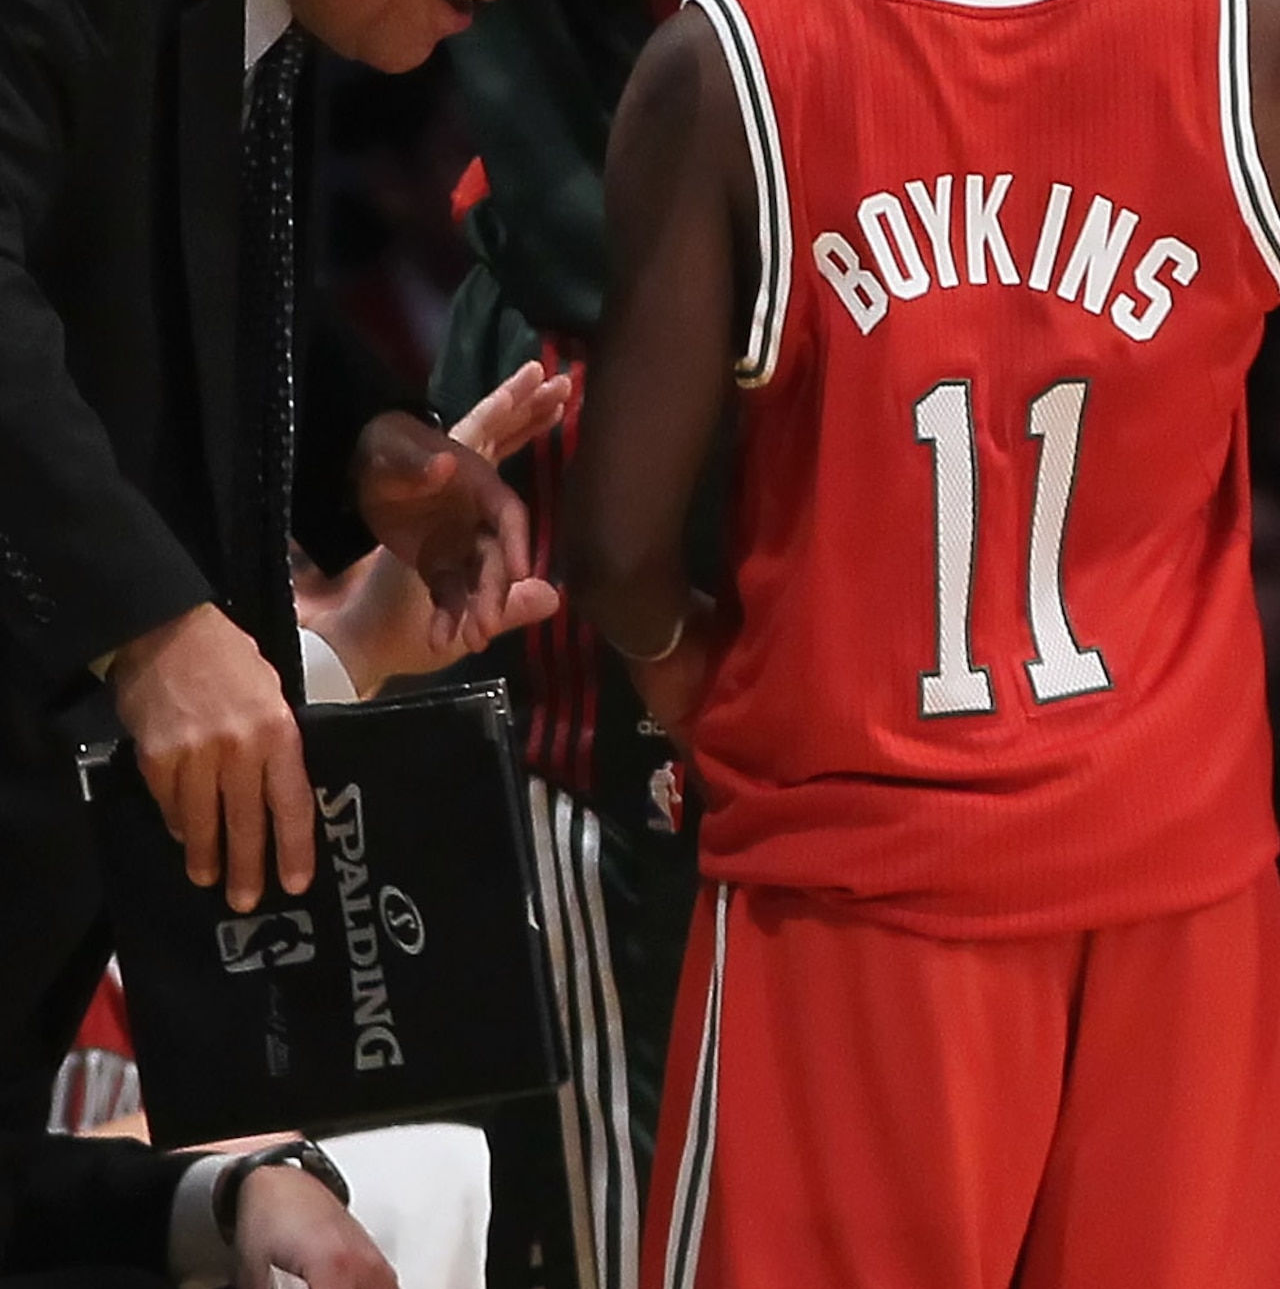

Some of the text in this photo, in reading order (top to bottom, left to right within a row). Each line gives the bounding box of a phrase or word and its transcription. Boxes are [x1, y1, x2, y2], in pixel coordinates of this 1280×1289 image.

[812, 173, 1200, 344] BOYKINS
[912, 376, 1115, 719] 11
[316, 782, 405, 1072] SPALDING
